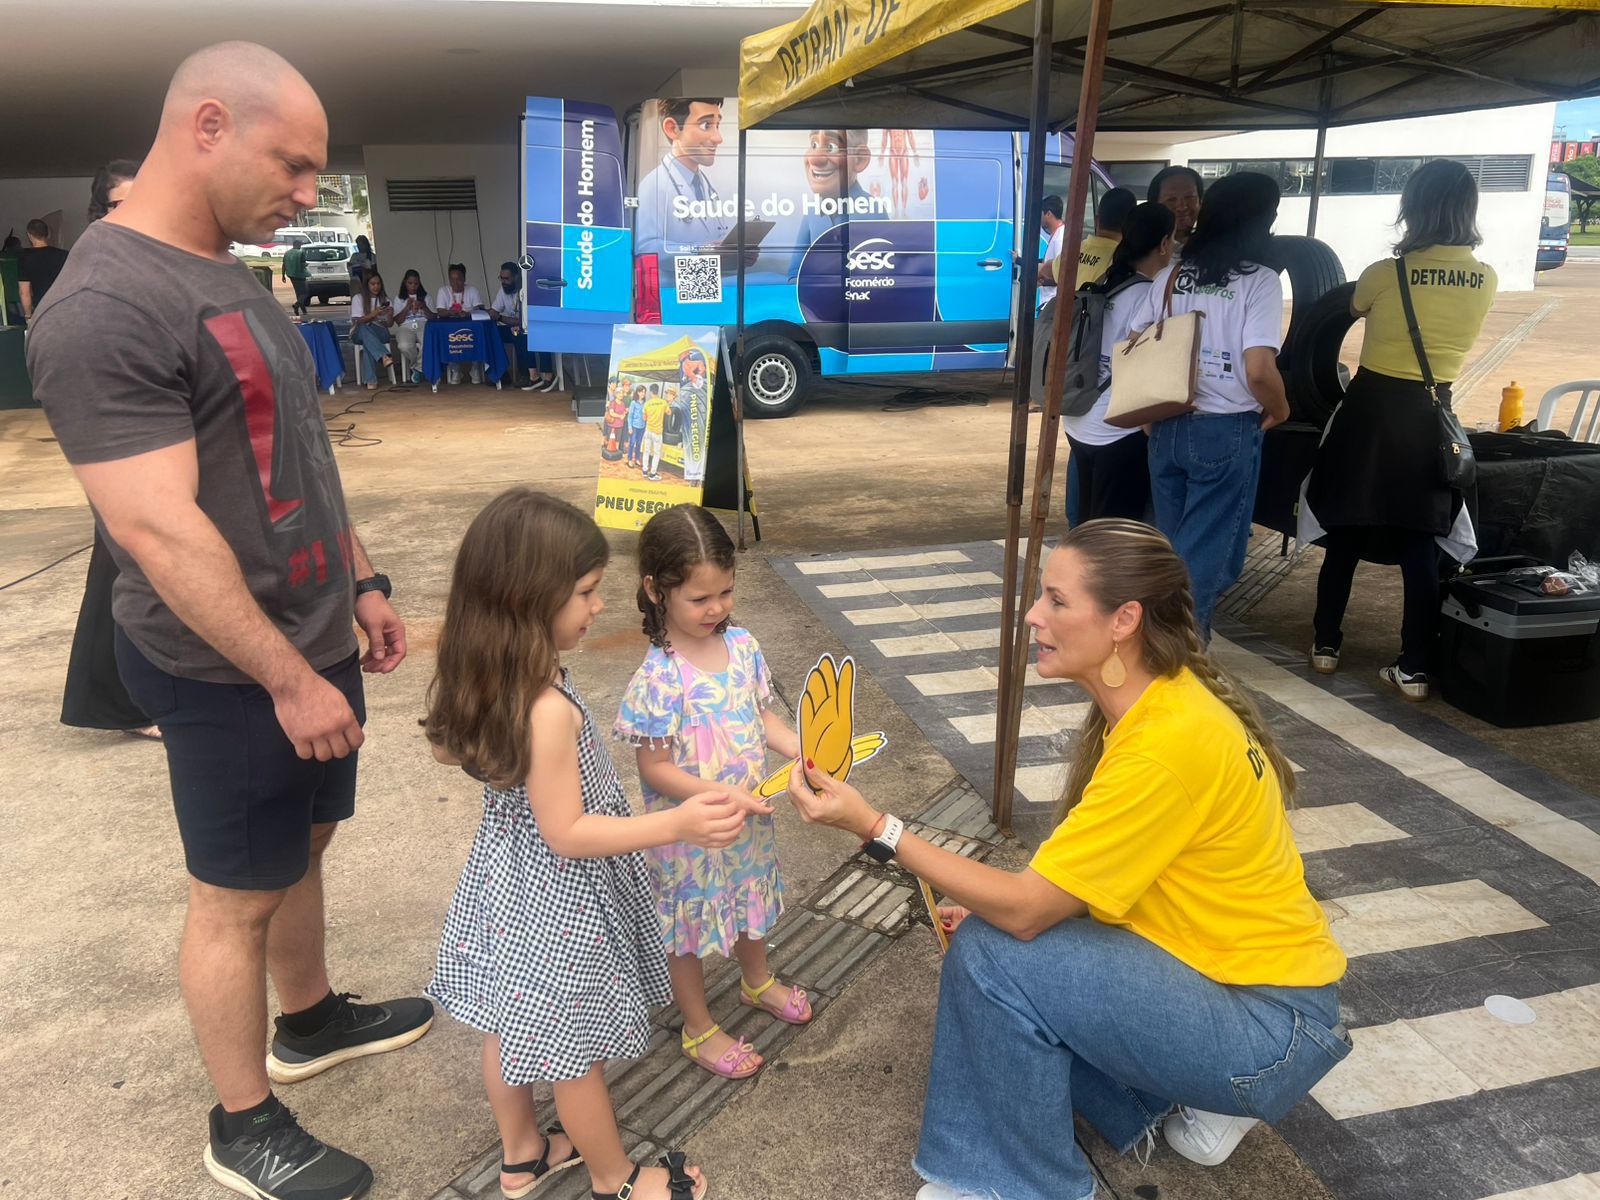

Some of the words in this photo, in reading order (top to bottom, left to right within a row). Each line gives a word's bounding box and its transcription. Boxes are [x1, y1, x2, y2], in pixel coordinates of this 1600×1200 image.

[777, 5, 849, 90] DETRAN
[578, 120, 595, 196] Homem
[577, 201, 594, 227] do
[672, 192, 756, 218] Saúde
[761, 192, 795, 216] do
[576, 230, 594, 290] Saúde
[1079, 252, 1101, 267] RAN-DF
[845, 276, 895, 288] Fcomércio
[1410, 268, 1485, 290] DETRAN-DF
[845, 290, 870, 301] Snac
[690, 393, 700, 420] PNEU
[596, 494, 634, 512] PNEU
[637, 499, 677, 514] SEG
